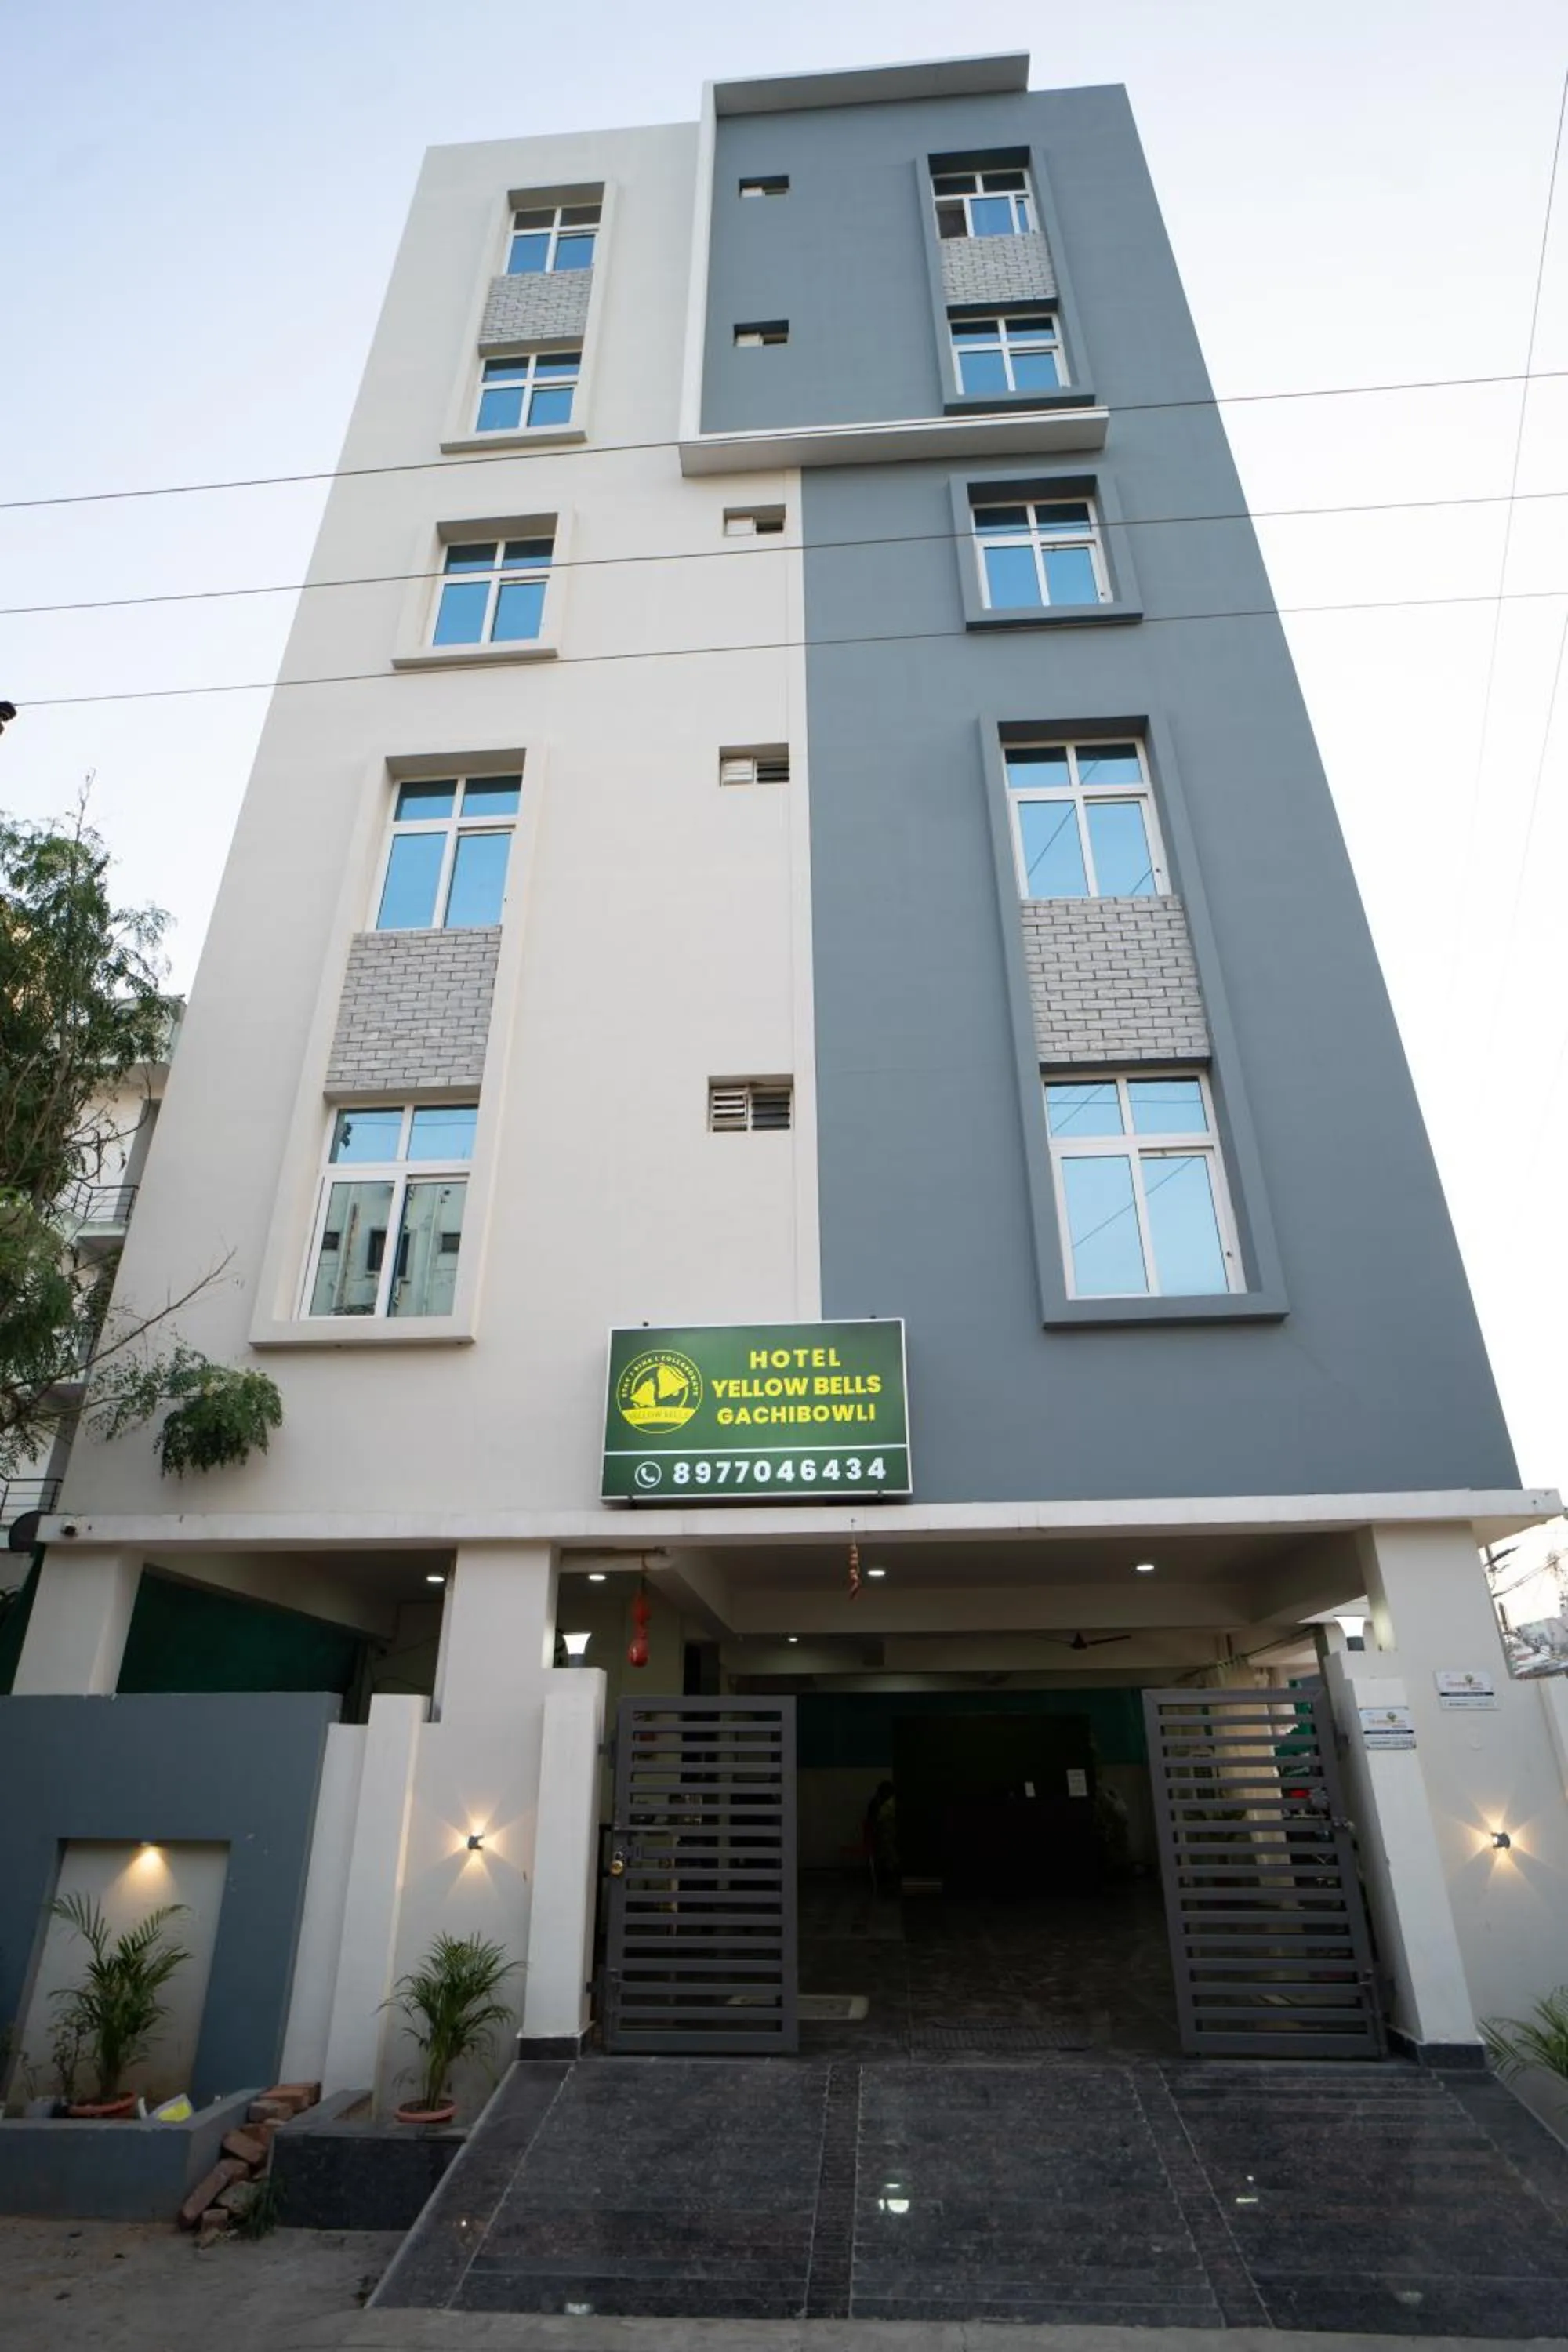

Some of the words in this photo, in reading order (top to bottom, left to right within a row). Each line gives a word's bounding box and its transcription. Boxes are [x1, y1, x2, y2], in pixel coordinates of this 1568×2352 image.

[749, 1348, 841, 1369] HOTEL
[711, 1377, 808, 1399] YELLOW
[814, 1375, 882, 1396] BELLS
[717, 1404, 876, 1425] GACHIBOWLI
[673, 1457, 887, 1484] 8977046434
